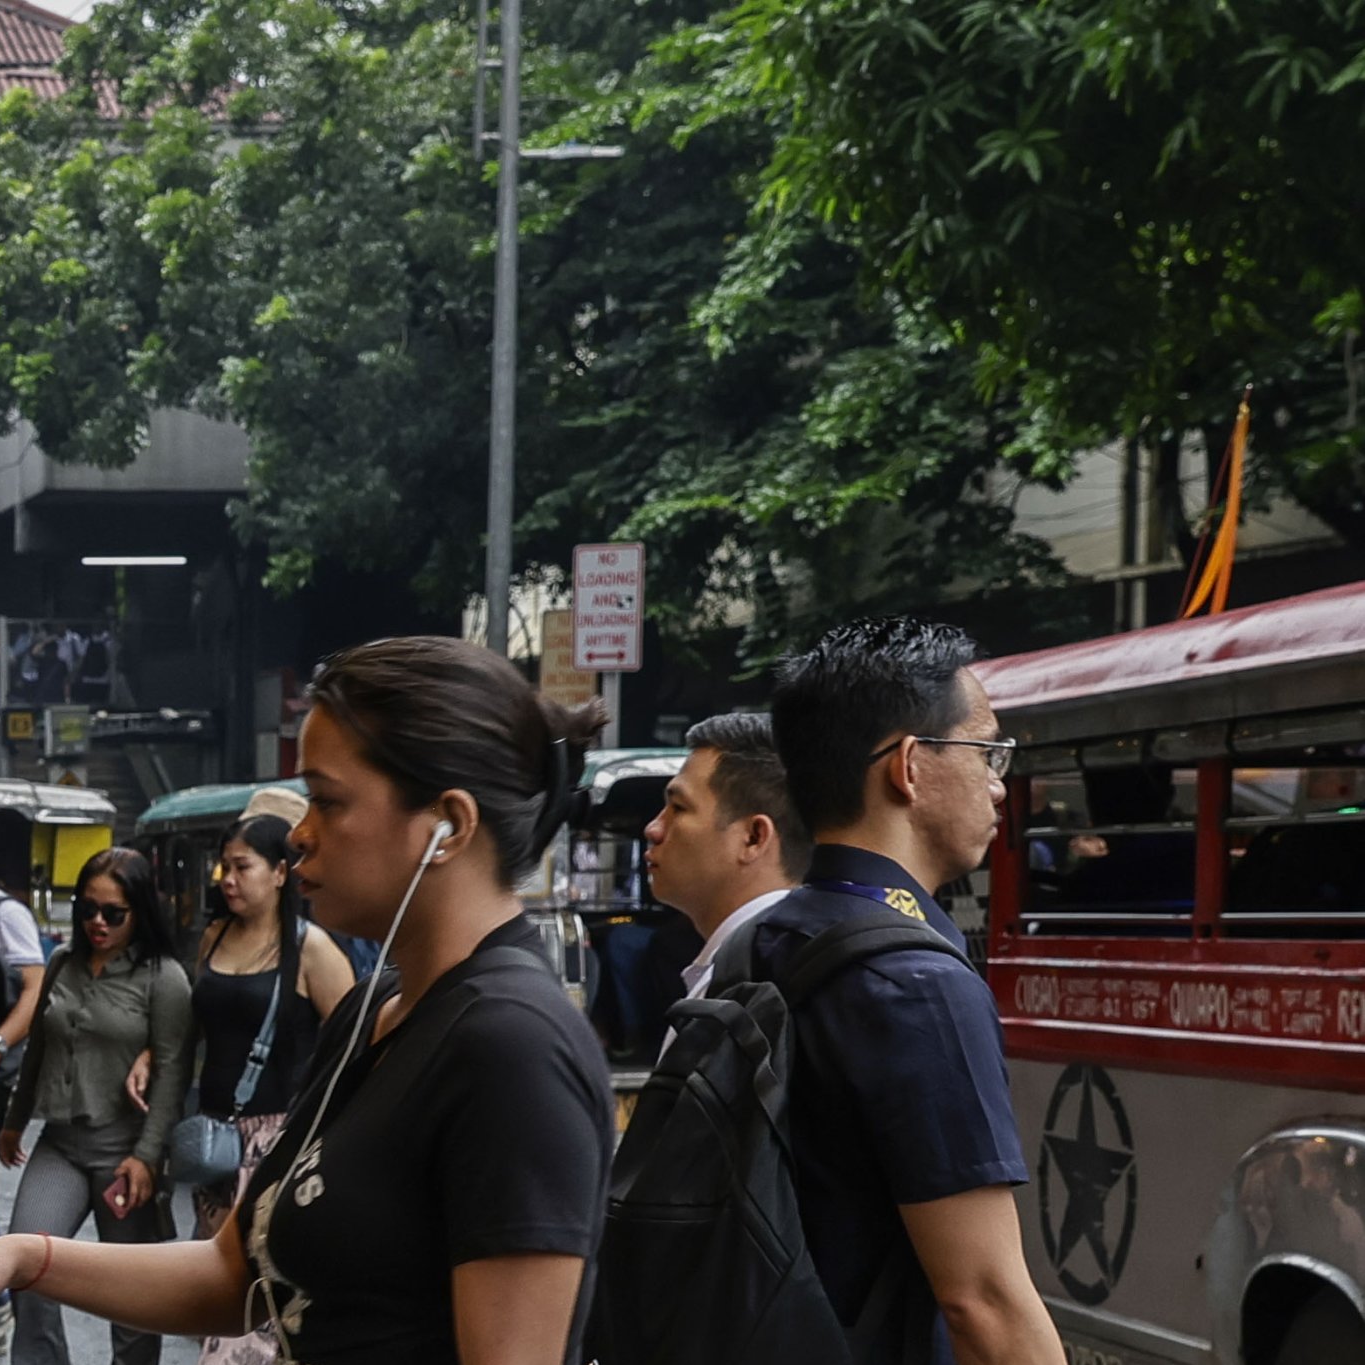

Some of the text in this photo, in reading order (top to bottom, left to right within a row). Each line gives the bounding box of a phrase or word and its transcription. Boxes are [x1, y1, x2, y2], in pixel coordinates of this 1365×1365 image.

[597, 552, 619, 566] NO
[579, 571, 637, 588] LOADING
[592, 592, 620, 607] AND
[576, 613, 636, 628] UNLOADING
[585, 633, 628, 647] ANYTIME
[1014, 974, 1060, 1017] CUBAO
[1170, 981, 1229, 1029] QUIAPO
